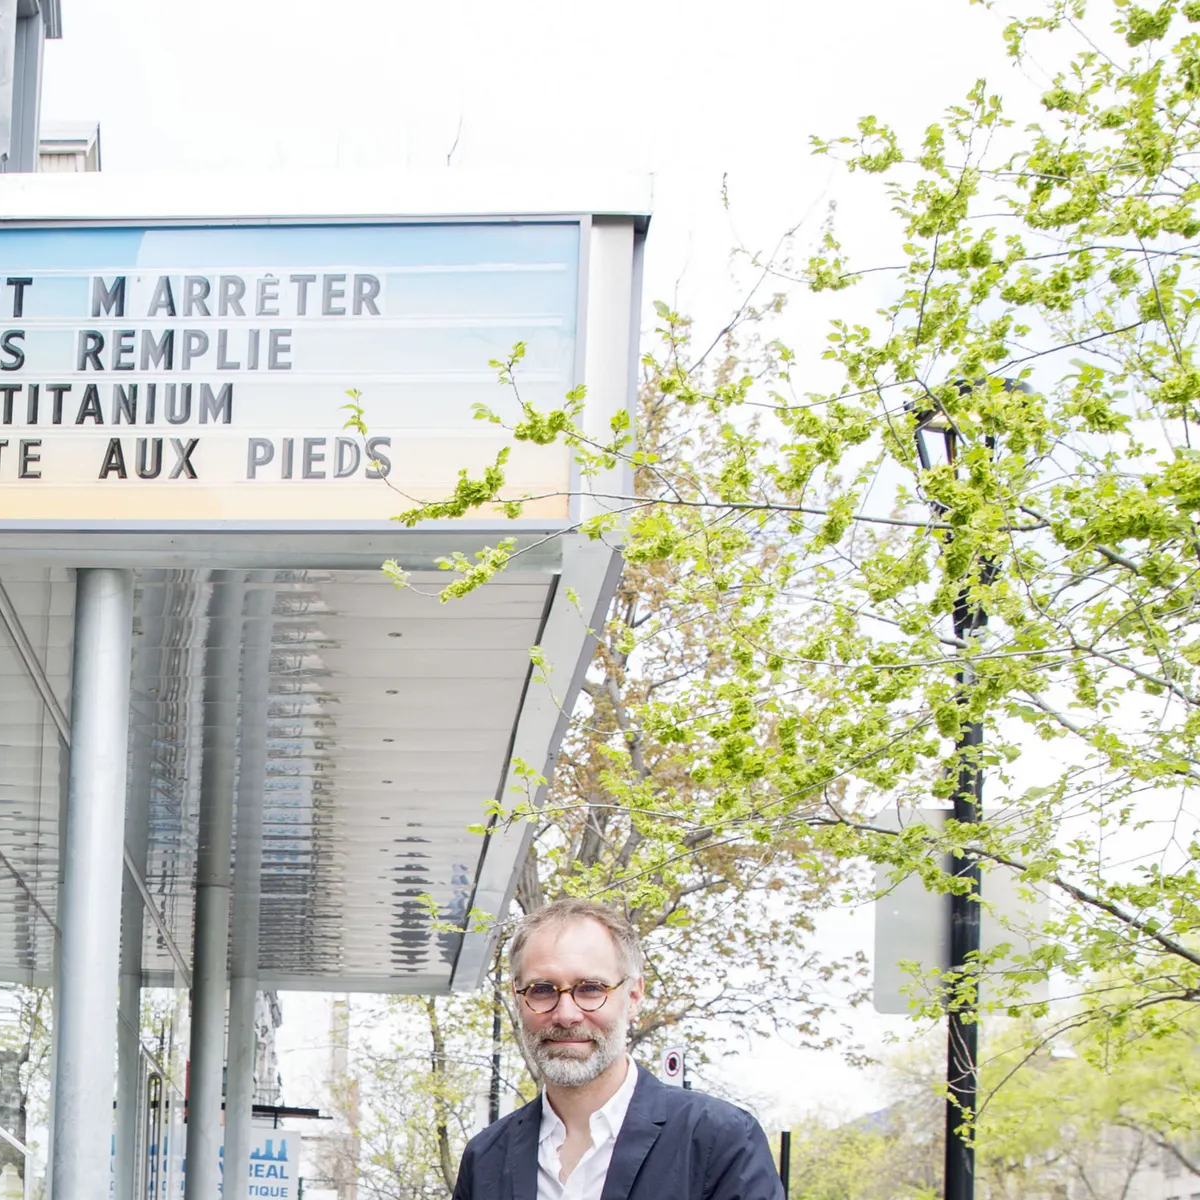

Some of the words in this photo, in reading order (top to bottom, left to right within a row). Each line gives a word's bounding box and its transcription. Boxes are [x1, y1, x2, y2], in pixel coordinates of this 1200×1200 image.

[76, 329, 293, 371] REMPLIE
[98, 437, 201, 479] AUX
[246, 436, 392, 480] PIEDS
